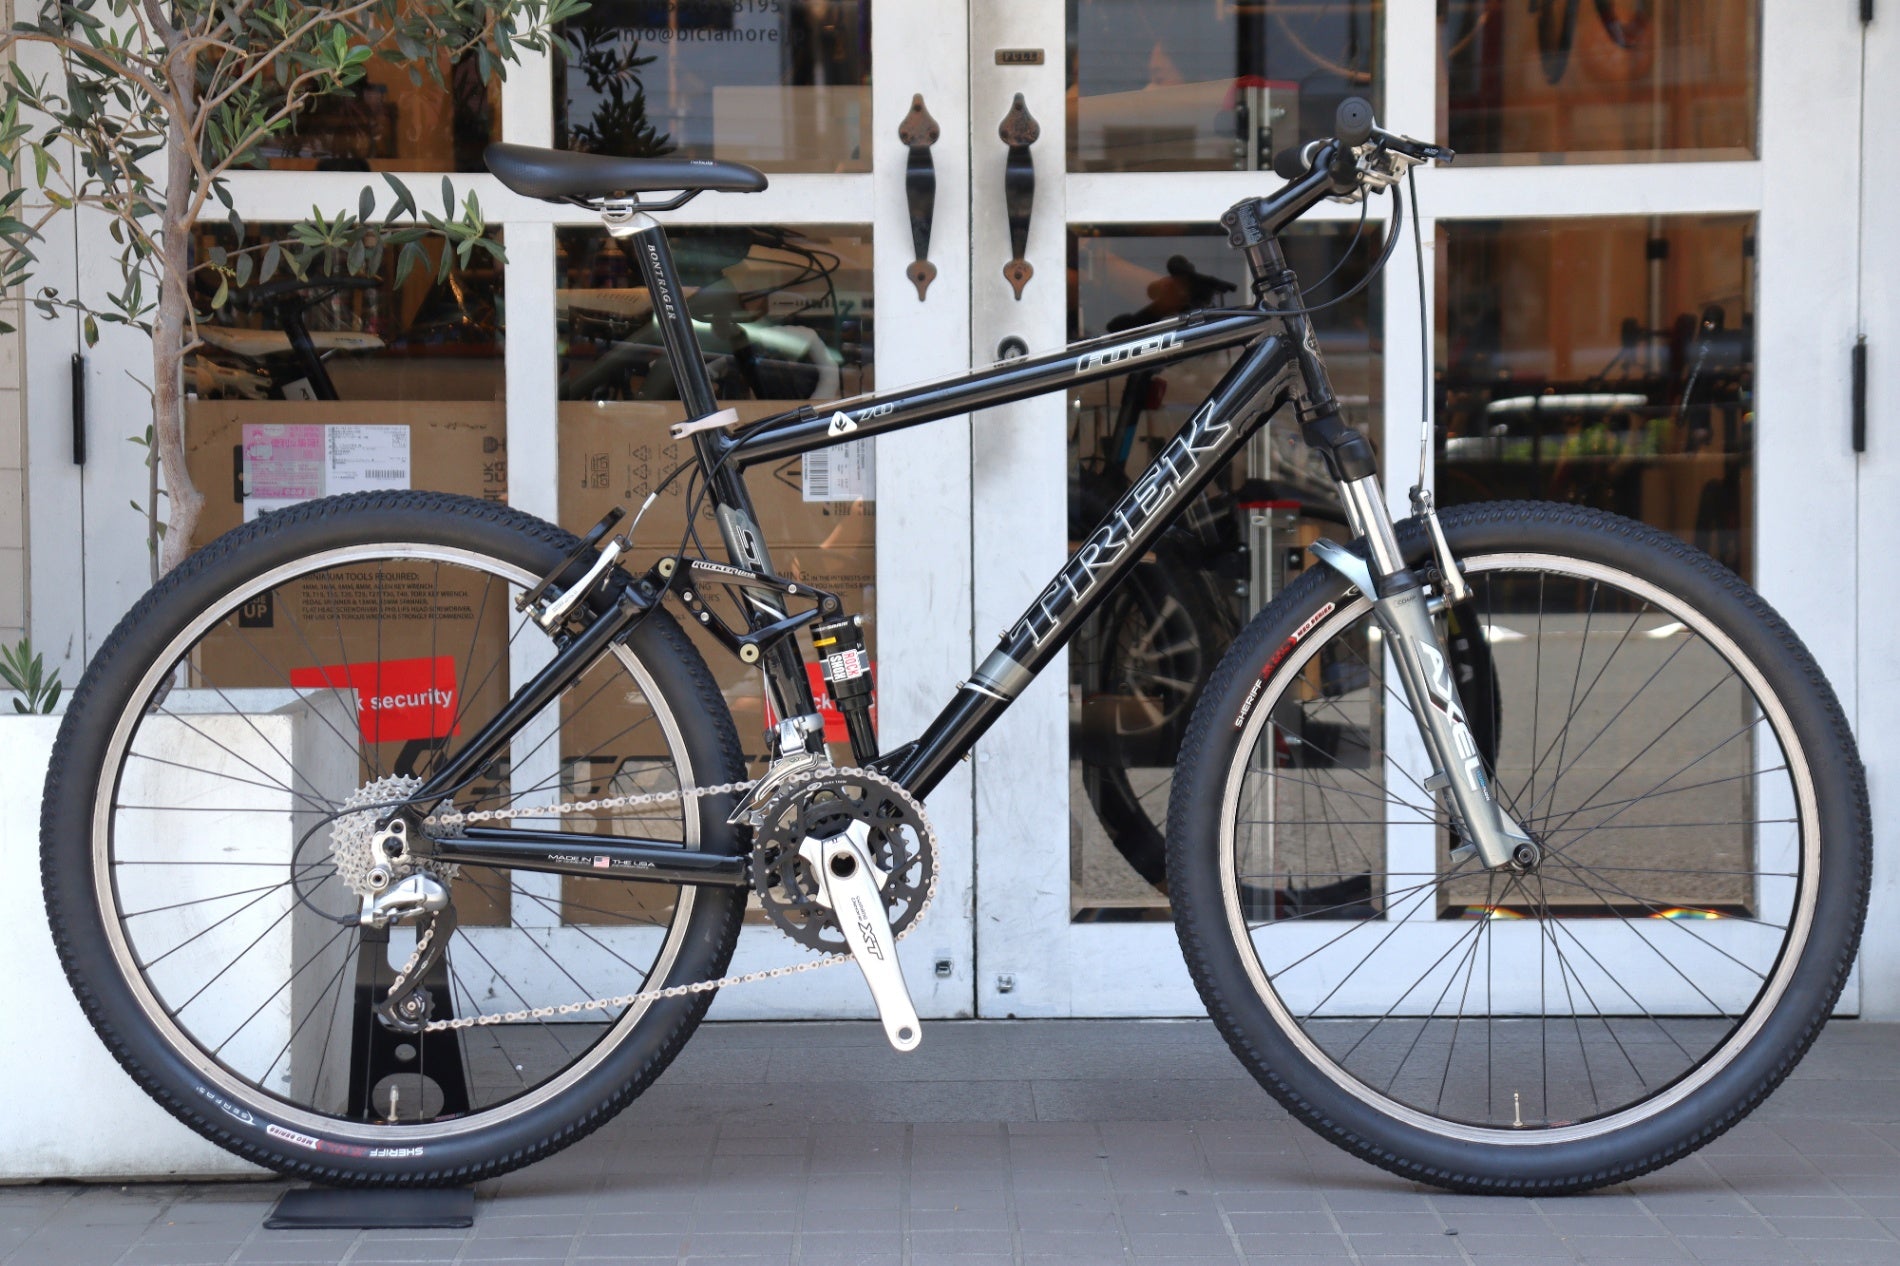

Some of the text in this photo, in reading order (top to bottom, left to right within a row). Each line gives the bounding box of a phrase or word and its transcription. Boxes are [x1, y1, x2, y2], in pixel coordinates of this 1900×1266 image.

[647, 244, 677, 320] BONTRAGER
[1010, 397, 1232, 648] TREK
[345, 573, 373, 581] TOOLS
[375, 573, 419, 581] REQUIRED:
[244, 604, 267, 618] UP
[843, 652, 860, 676] ROCK
[370, 687, 452, 710] security
[1234, 679, 1263, 728] SHERIFF
[1418, 640, 1480, 791] AXEL
[858, 922, 884, 961] XT
[368, 1145, 424, 1158] SHERIFF
